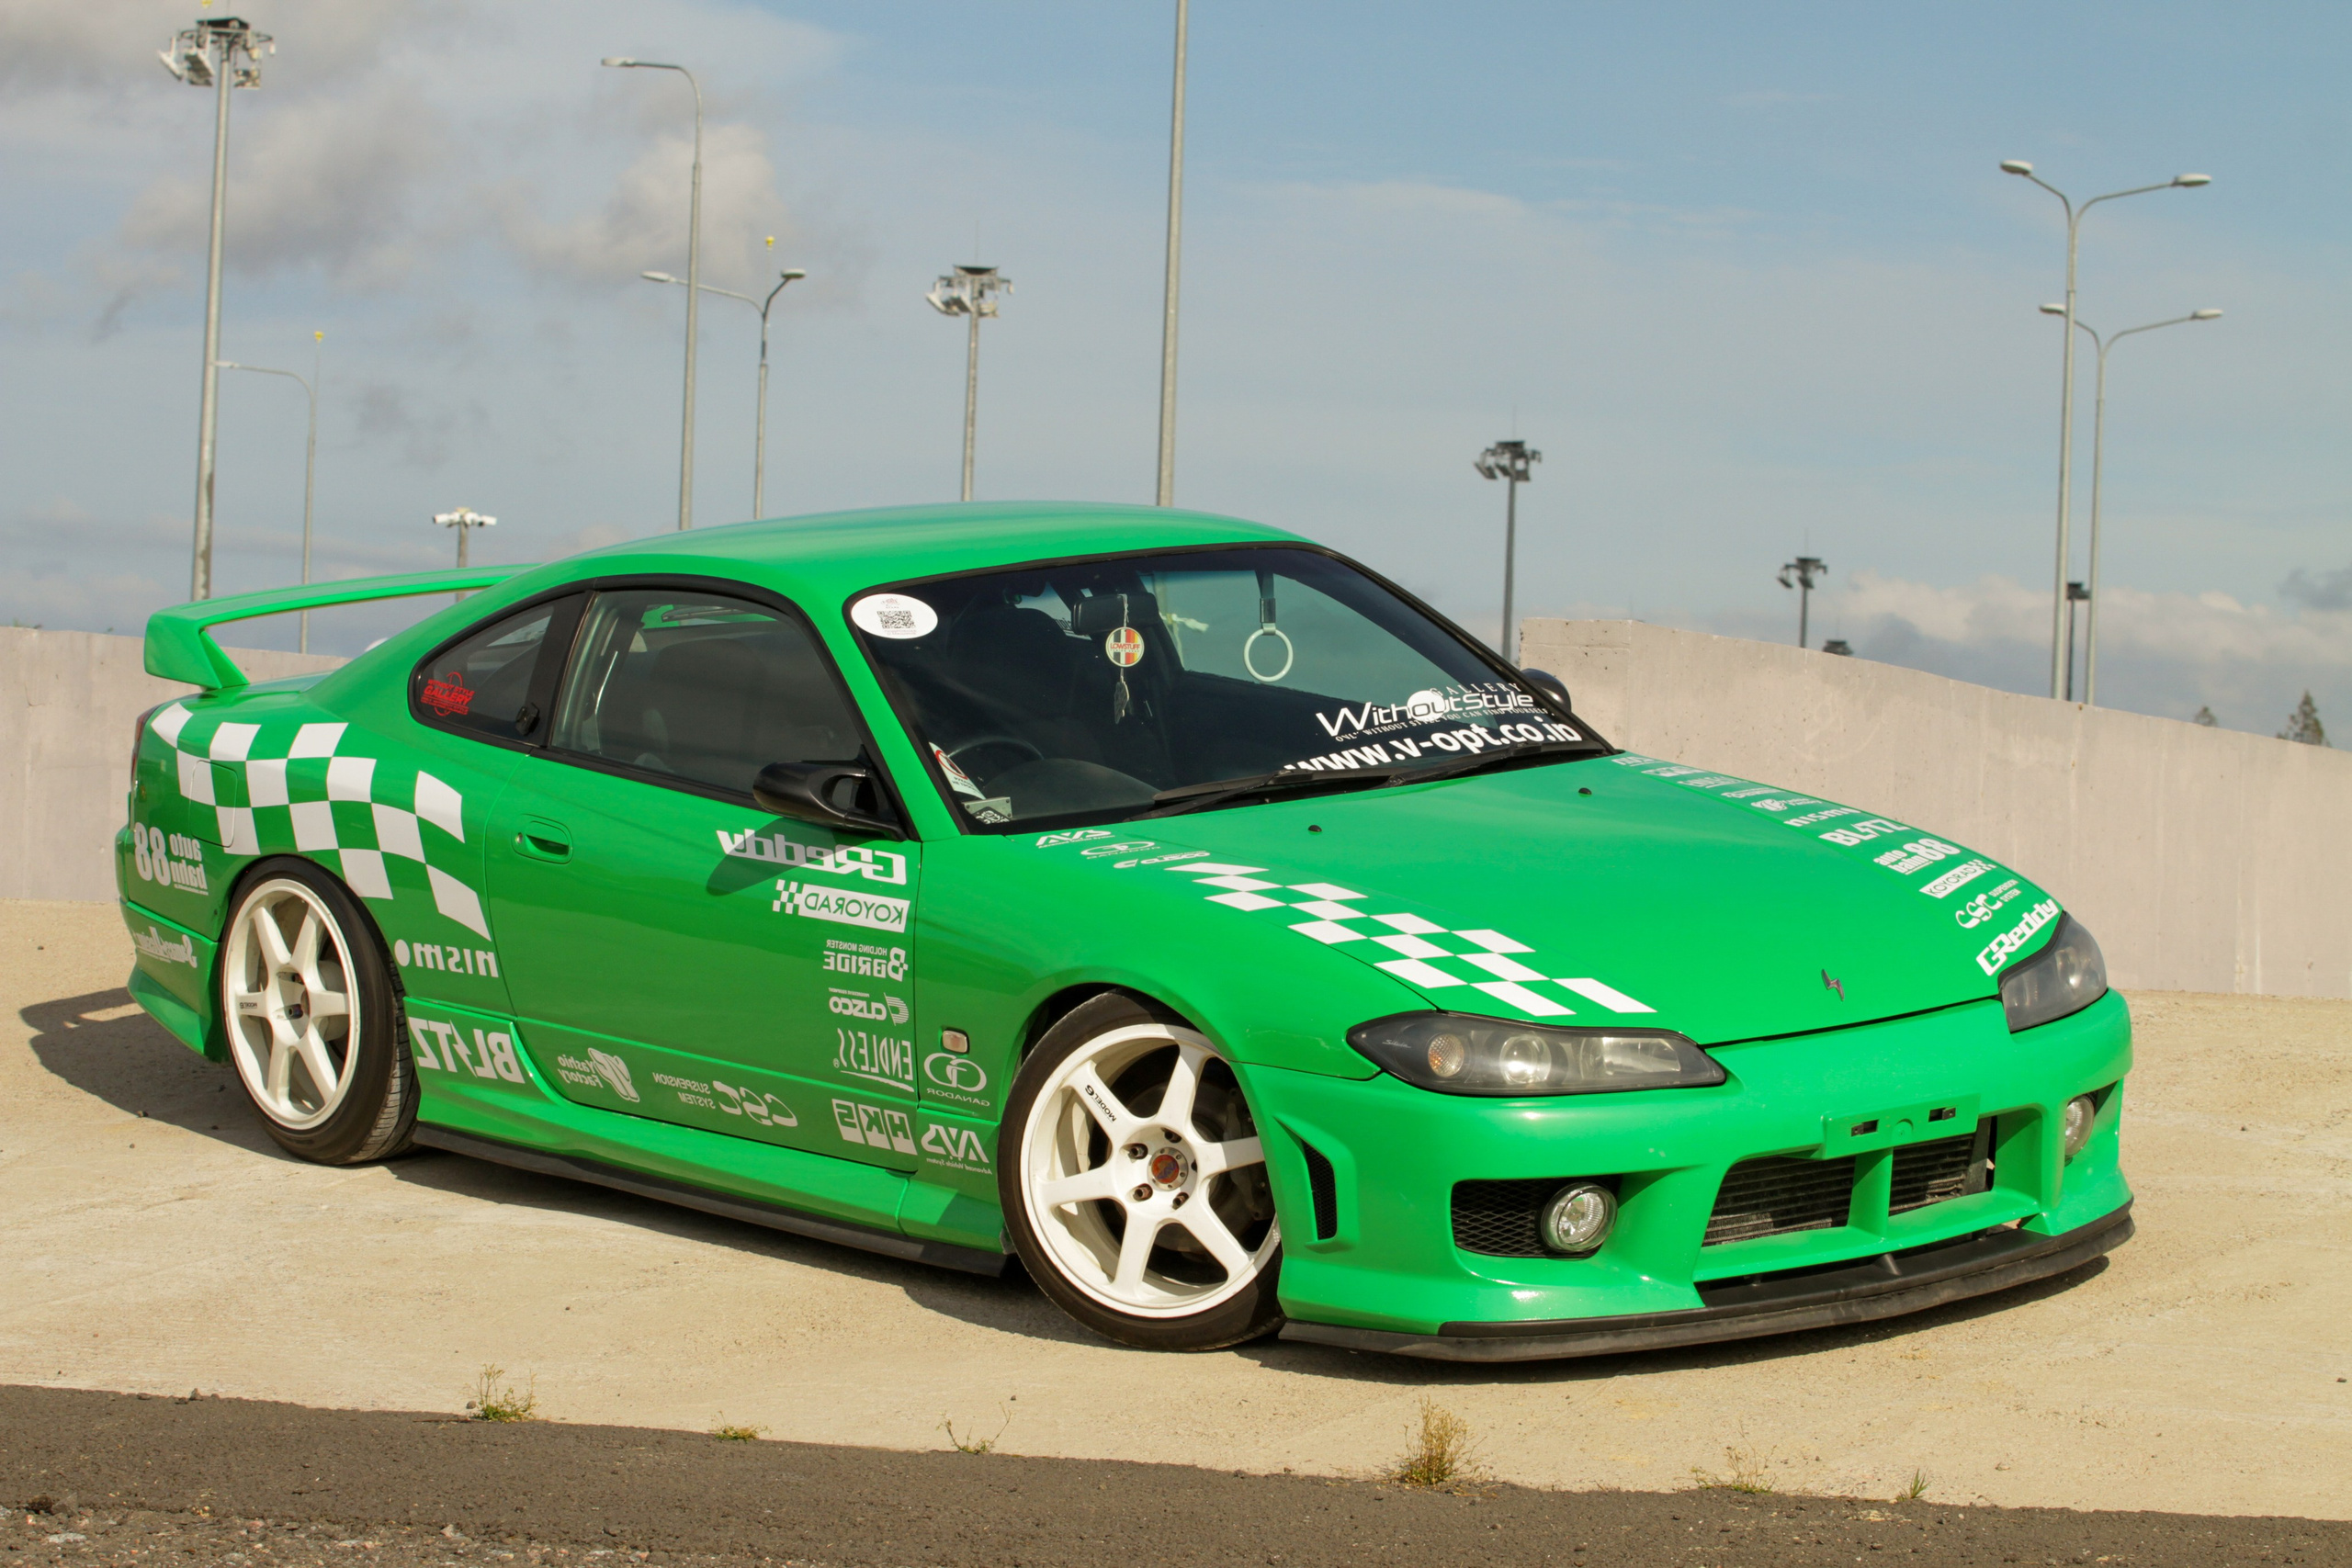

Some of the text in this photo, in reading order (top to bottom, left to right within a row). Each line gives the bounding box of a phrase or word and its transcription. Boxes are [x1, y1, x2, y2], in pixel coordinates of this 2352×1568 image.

[424, 684, 472, 705] GALLERY
[1429, 682, 1522, 697] GALLERY
[1363, 722, 1408, 736] WITHOUT
[1463, 710, 1483, 718] CAN
[1873, 850, 1907, 866] auto
[1903, 838, 1962, 861] 88
[1928, 867, 1978, 895] KOYORAD
[1976, 898, 2060, 976] GReddy
